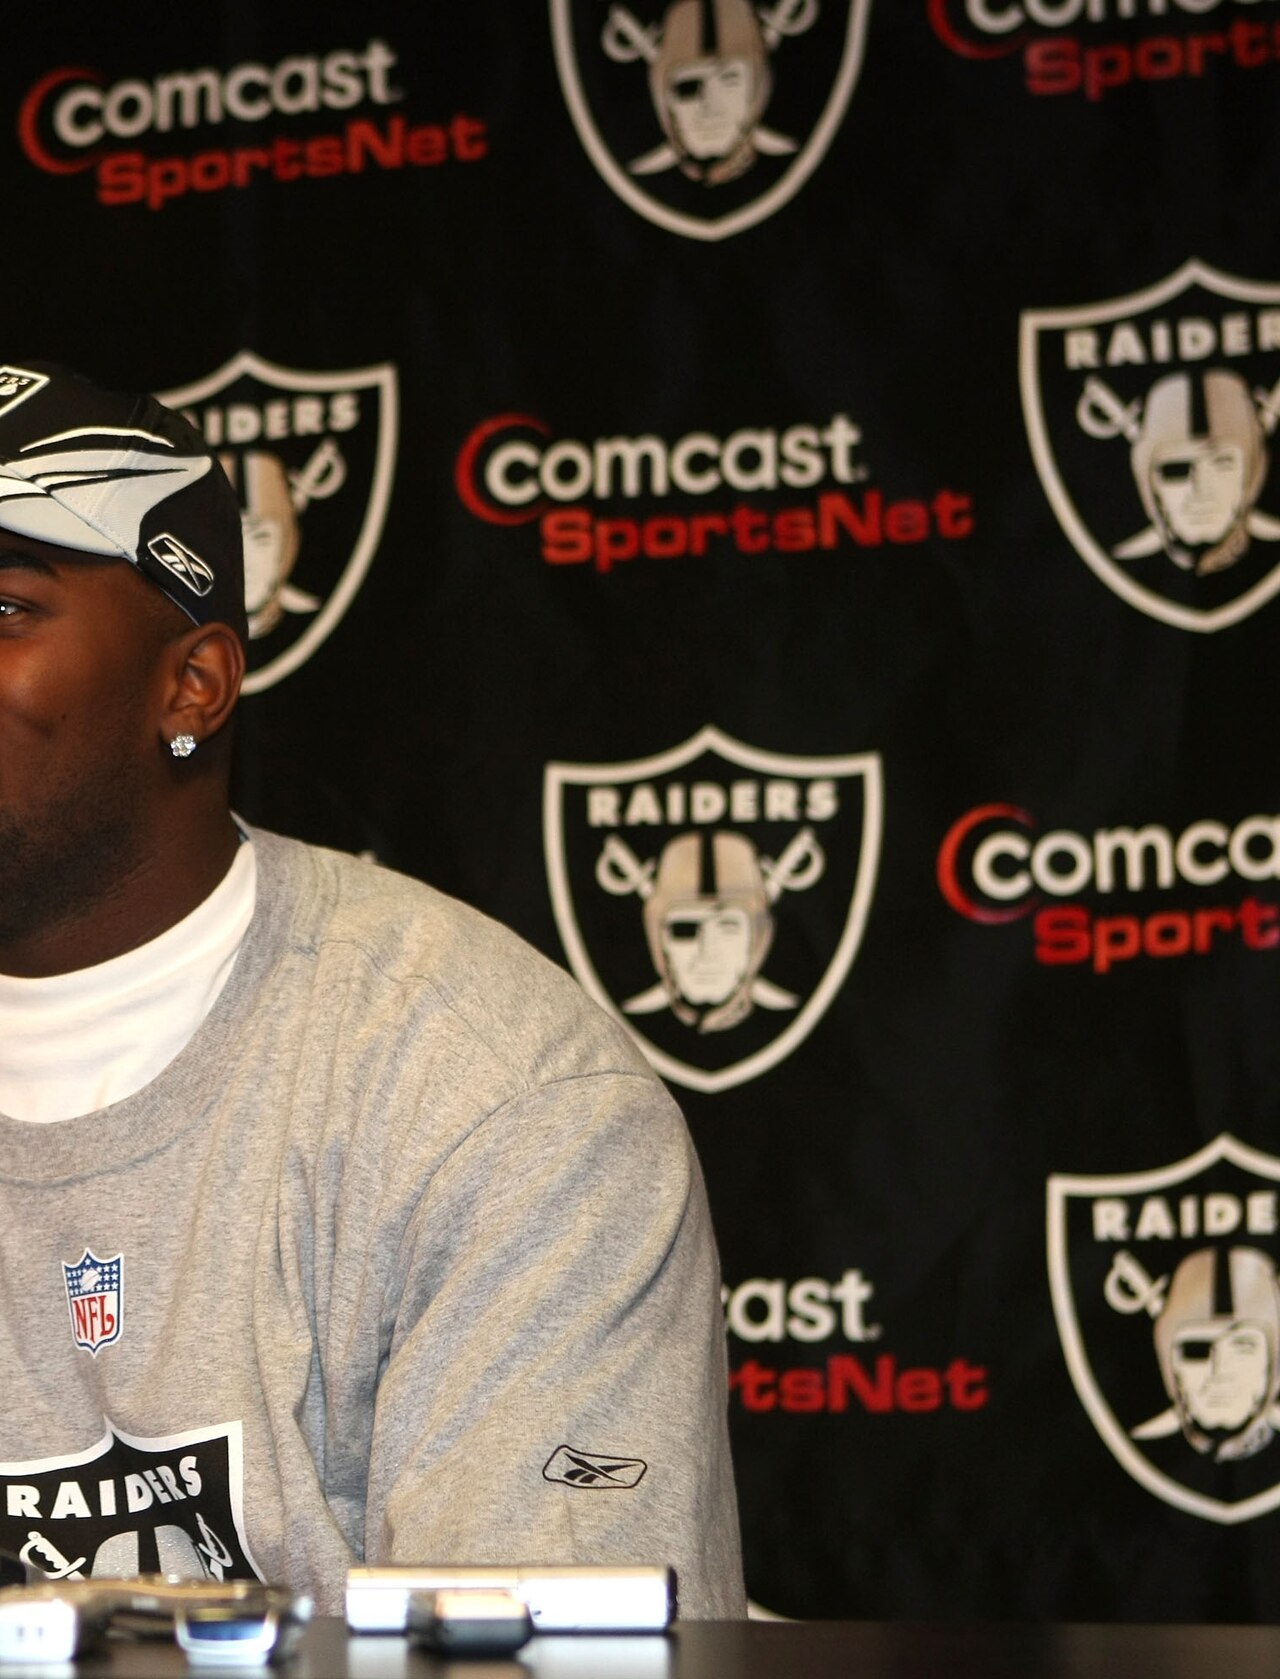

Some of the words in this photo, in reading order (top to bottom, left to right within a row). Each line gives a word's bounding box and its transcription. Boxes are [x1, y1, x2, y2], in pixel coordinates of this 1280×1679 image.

[98, 115, 487, 210] SportsNet
[541, 489, 975, 573] SportsNet
[586, 777, 841, 828] RAIDERS
[73, 1295, 115, 1342] NFL
[720, 1267, 874, 1343] ast
[6, 1456, 203, 1520] RAIDERS
